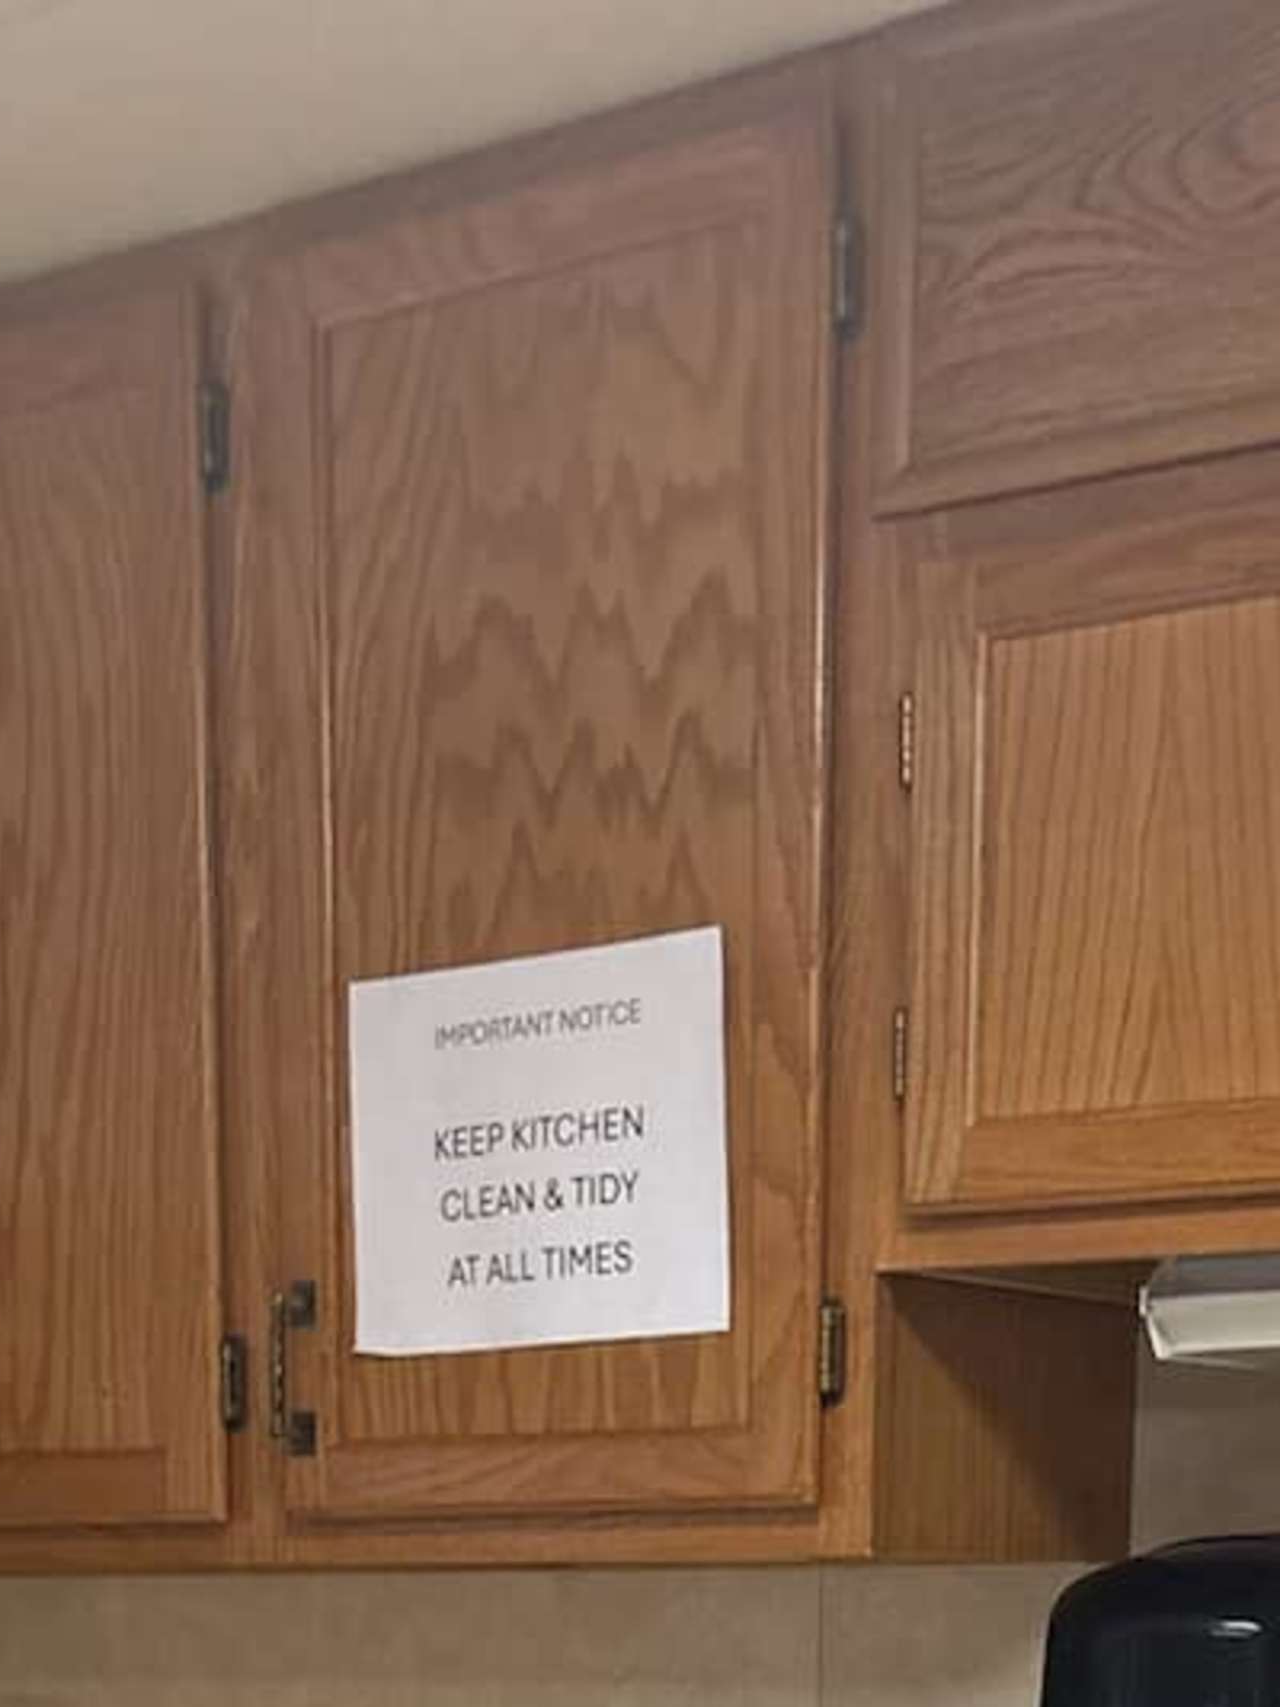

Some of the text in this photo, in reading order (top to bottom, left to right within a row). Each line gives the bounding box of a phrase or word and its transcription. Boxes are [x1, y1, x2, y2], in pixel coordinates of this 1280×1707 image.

[435, 998, 641, 1050] IMPORTANT NOTICE
[434, 1105, 644, 1161] KEEP KITCHEN
[440, 1170, 639, 1222] CLEAN & TIDY
[447, 1240, 633, 1287] AT ALL TIMES
